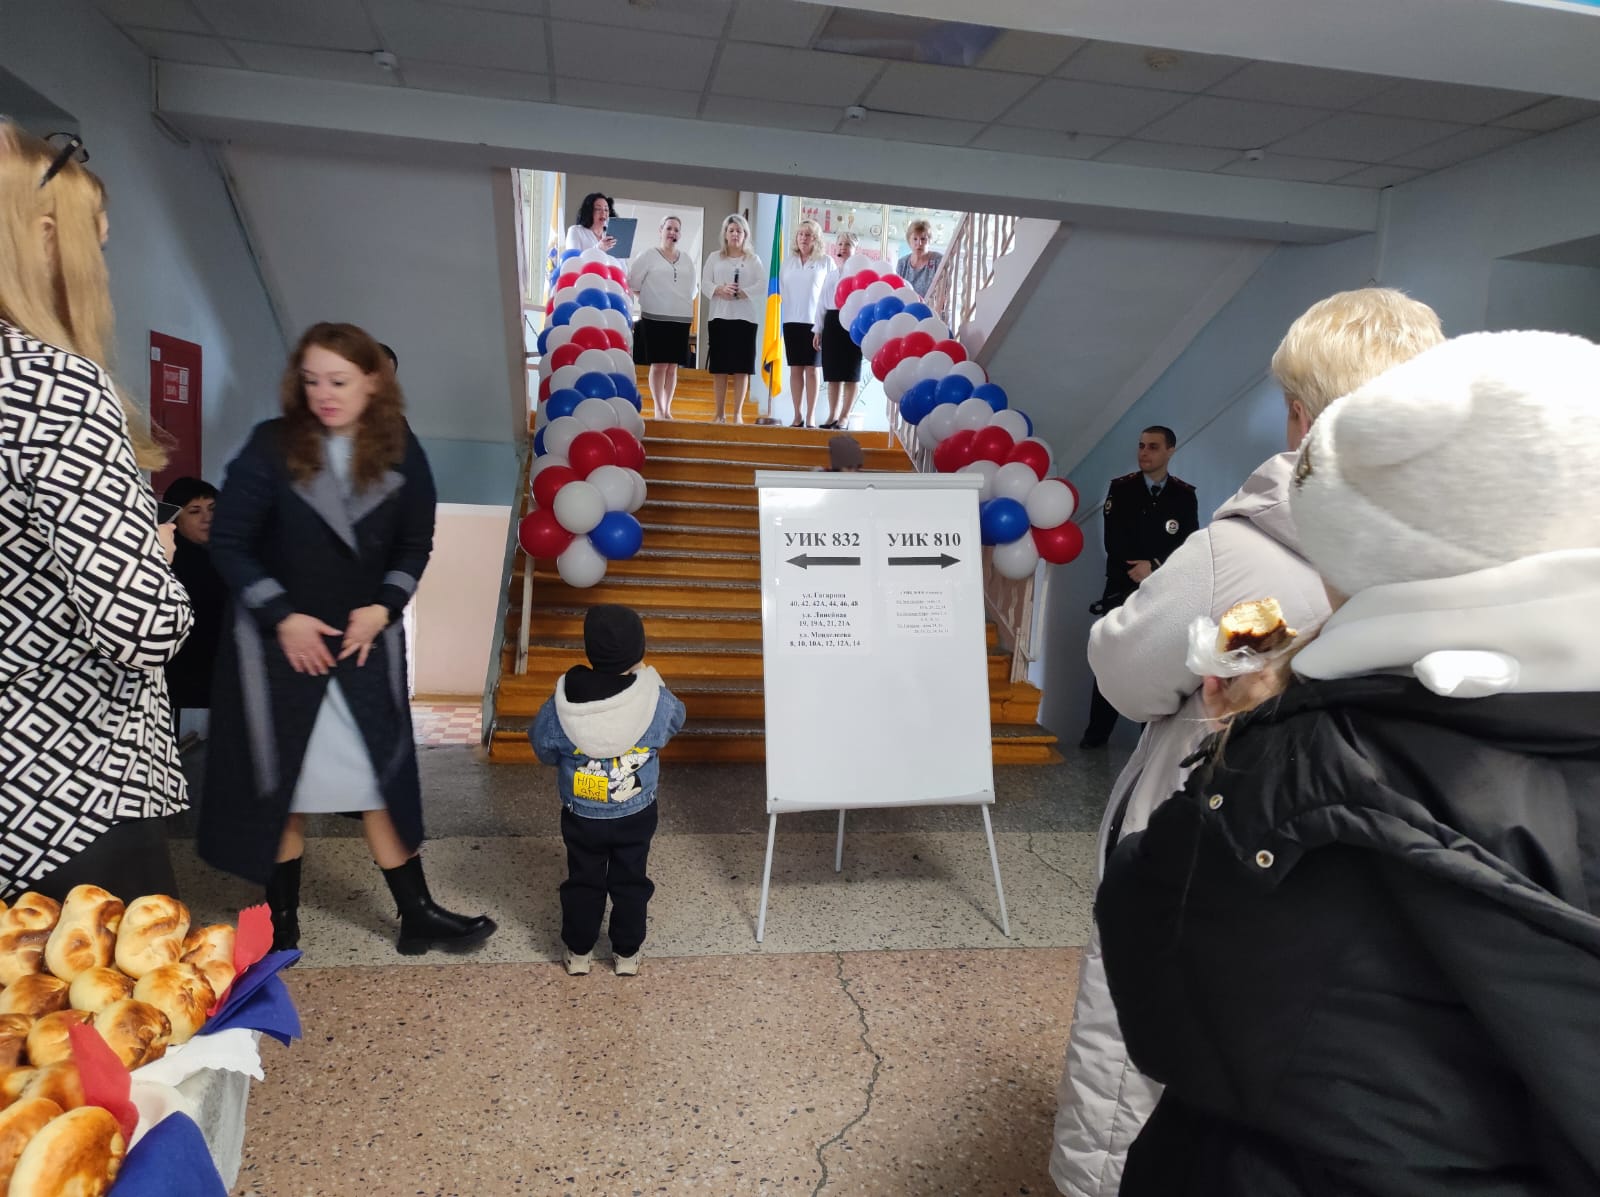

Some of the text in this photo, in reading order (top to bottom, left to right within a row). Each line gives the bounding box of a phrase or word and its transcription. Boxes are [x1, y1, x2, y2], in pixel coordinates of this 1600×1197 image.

[784, 533, 860, 546] УИК 832
[888, 533, 961, 546] УИК 810
[578, 777, 605, 791] HIDE
[581, 788, 600, 797] and
